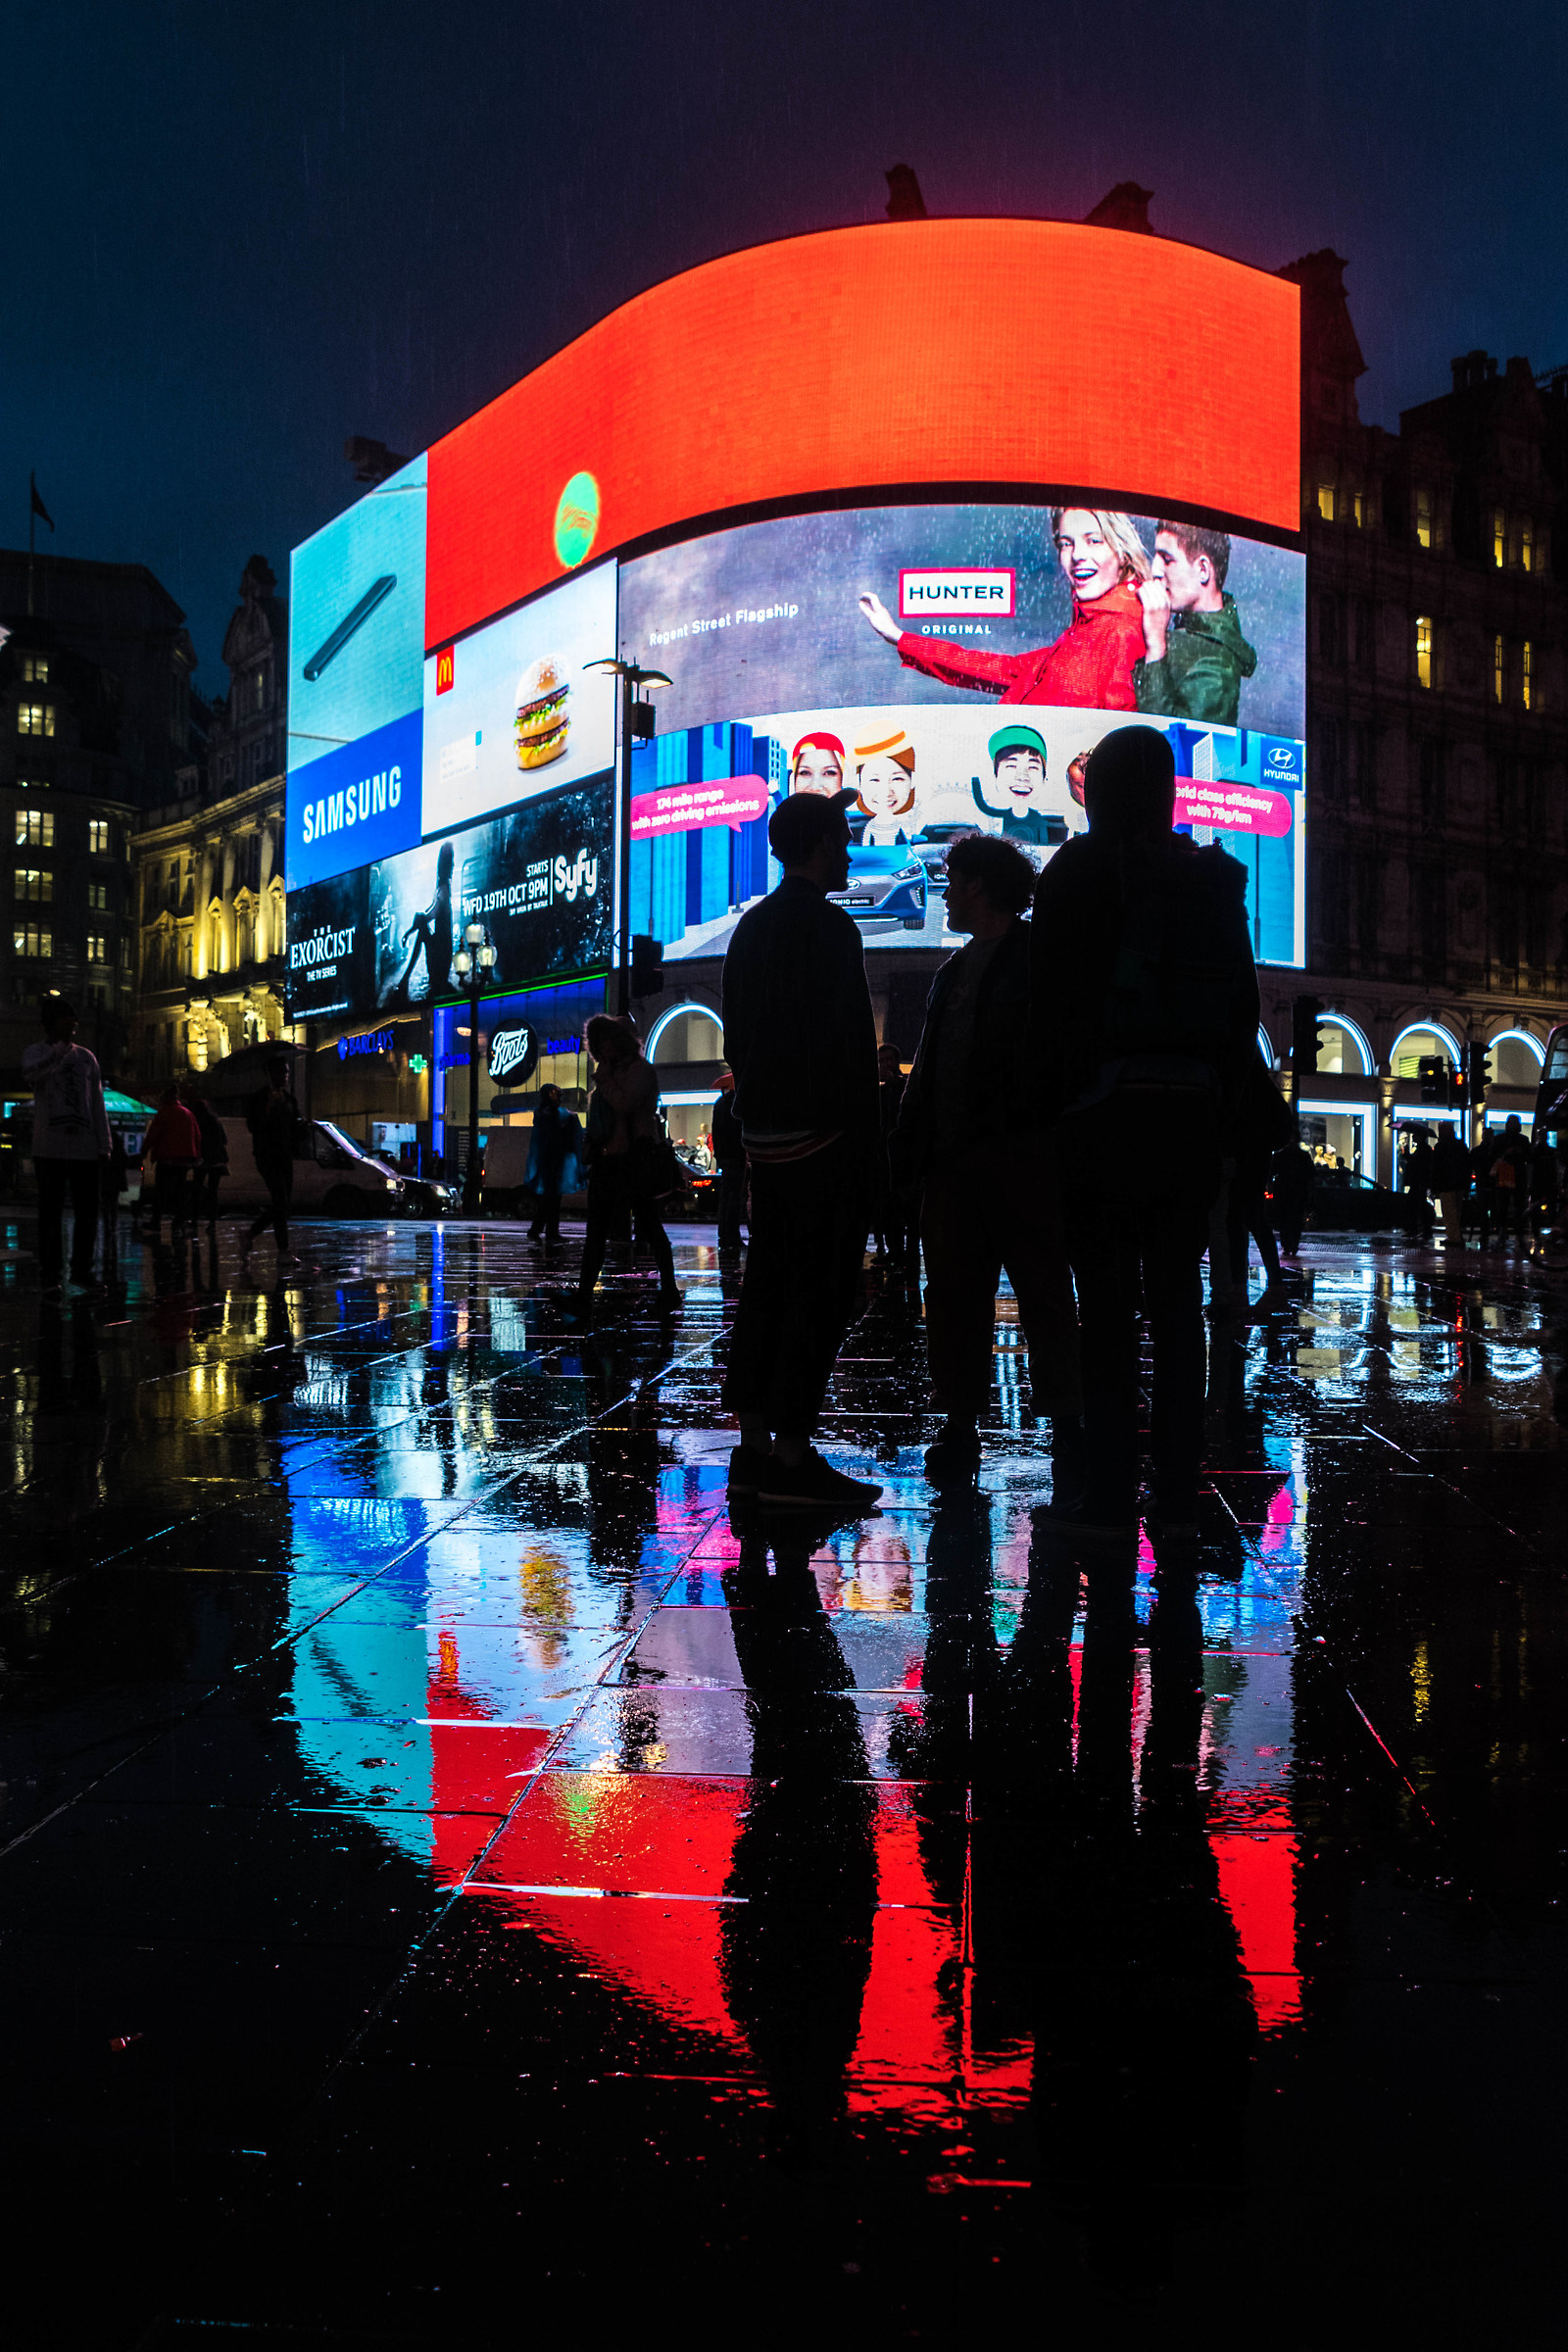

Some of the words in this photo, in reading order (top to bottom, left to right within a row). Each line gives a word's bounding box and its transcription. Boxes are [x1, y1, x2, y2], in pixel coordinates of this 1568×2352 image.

[909, 585, 1004, 600] HUNTER
[649, 623, 689, 647] Regent
[691, 613, 731, 635] Street
[735, 602, 799, 624] Flagship
[921, 624, 992, 636] ORIGINAL
[1263, 768, 1299, 783] HYUNDAI
[303, 765, 402, 844] SAMSUNG
[657, 796, 672, 810] 174
[672, 793, 693, 807] mile
[694, 789, 724, 804] range
[1175, 785, 1197, 799] orld
[1198, 788, 1225, 804] class
[1225, 792, 1273, 813] efficiency
[1186, 803, 1211, 818] with
[631, 815, 651, 831] with
[652, 813, 670, 827] zero
[671, 807, 705, 821] driving
[706, 800, 760, 816] emissions
[526, 859, 549, 877] STARTS
[554, 847, 598, 903] Syfy
[483, 888, 507, 912] 19TH
[508, 883, 527, 905] OCT
[528, 876, 549, 900] 9PM
[290, 925, 356, 969] EXORCIST
[348, 1030, 394, 1056] BARCLAYS
[488, 1027, 528, 1077] Boots
[547, 1035, 580, 1055] beauty
